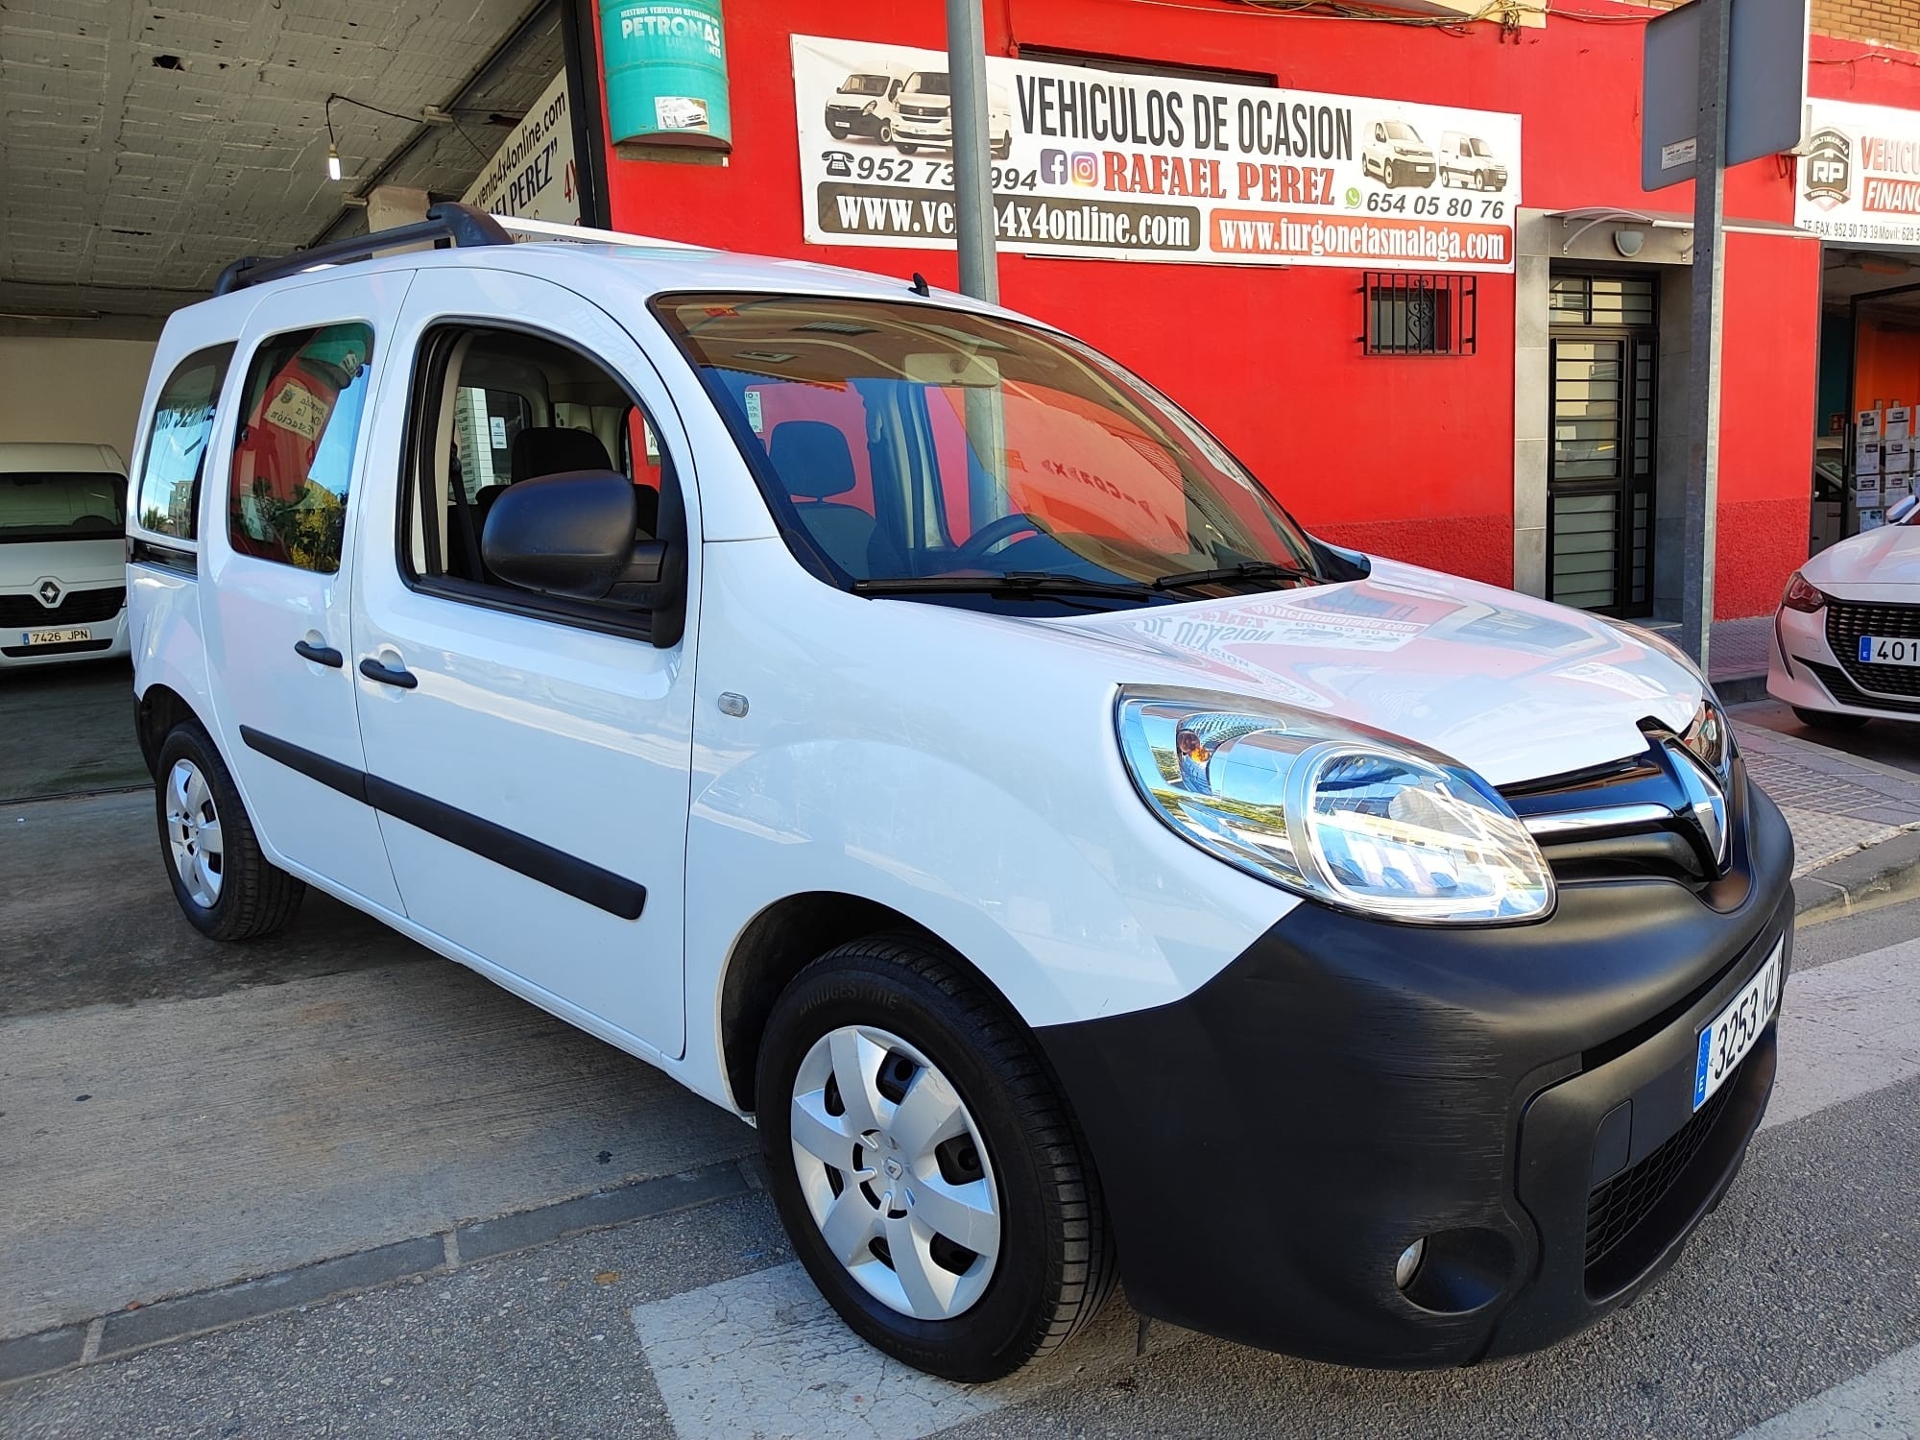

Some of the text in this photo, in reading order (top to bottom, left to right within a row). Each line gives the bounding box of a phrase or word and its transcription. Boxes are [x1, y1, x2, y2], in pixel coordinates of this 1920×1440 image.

[621, 15, 720, 47] PETRONAS
[1016, 74, 1353, 161] VEHICULOS DE OCASION
[856, 156, 911, 183] 952
[1104, 150, 1336, 206] RAFAEL PEREZ
[1812, 160, 1845, 183] RP
[1366, 192, 1505, 220] 654 05 80 76
[1218, 217, 1505, 262] www.furgonetasmalaga.com
[1834, 222, 1847, 237] 952
[1848, 223, 1858, 238] 50
[1859, 224, 1868, 239] 79
[32, 630, 88, 643] 7426 JPN
[1714, 987, 1759, 1080] 3253
